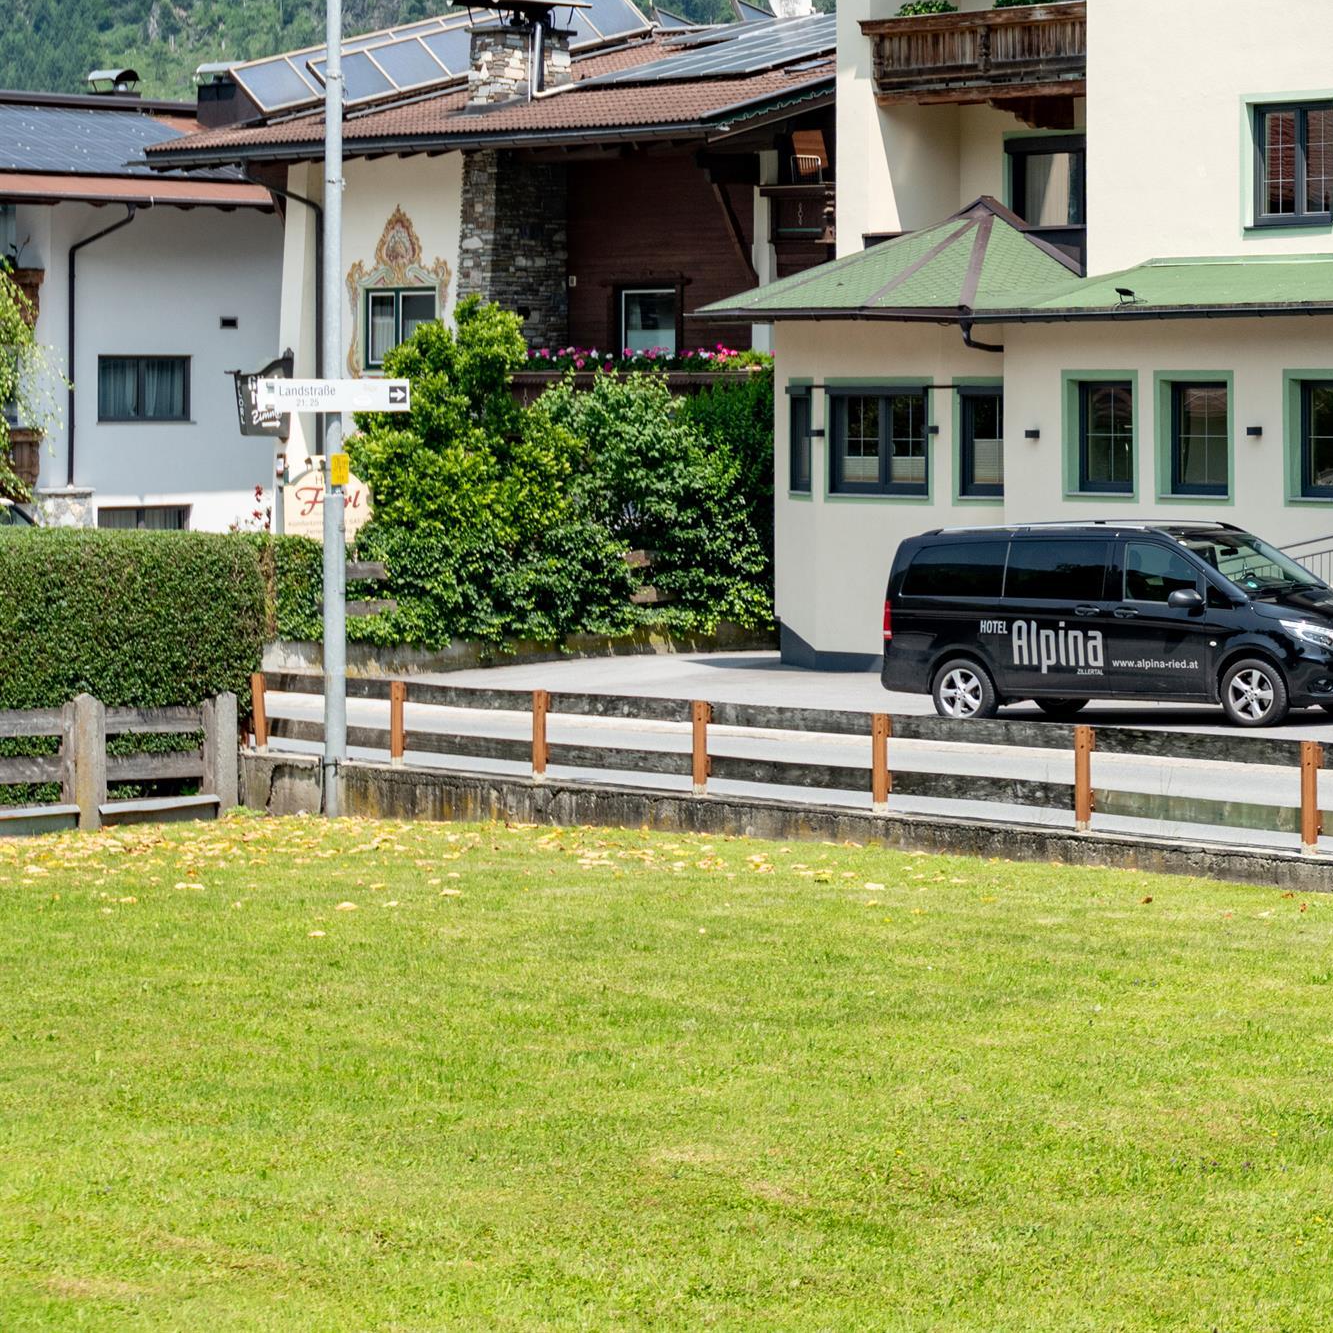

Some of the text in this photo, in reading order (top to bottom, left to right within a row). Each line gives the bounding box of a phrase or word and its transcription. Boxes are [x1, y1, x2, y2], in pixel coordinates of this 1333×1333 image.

[279, 385, 336, 397] Landstraße
[979, 619, 1104, 674] HOTEL Alpina
[1112, 658, 1199, 670] www.alpina-ried.at
[1076, 668, 1104, 676] ZILLERTAL
